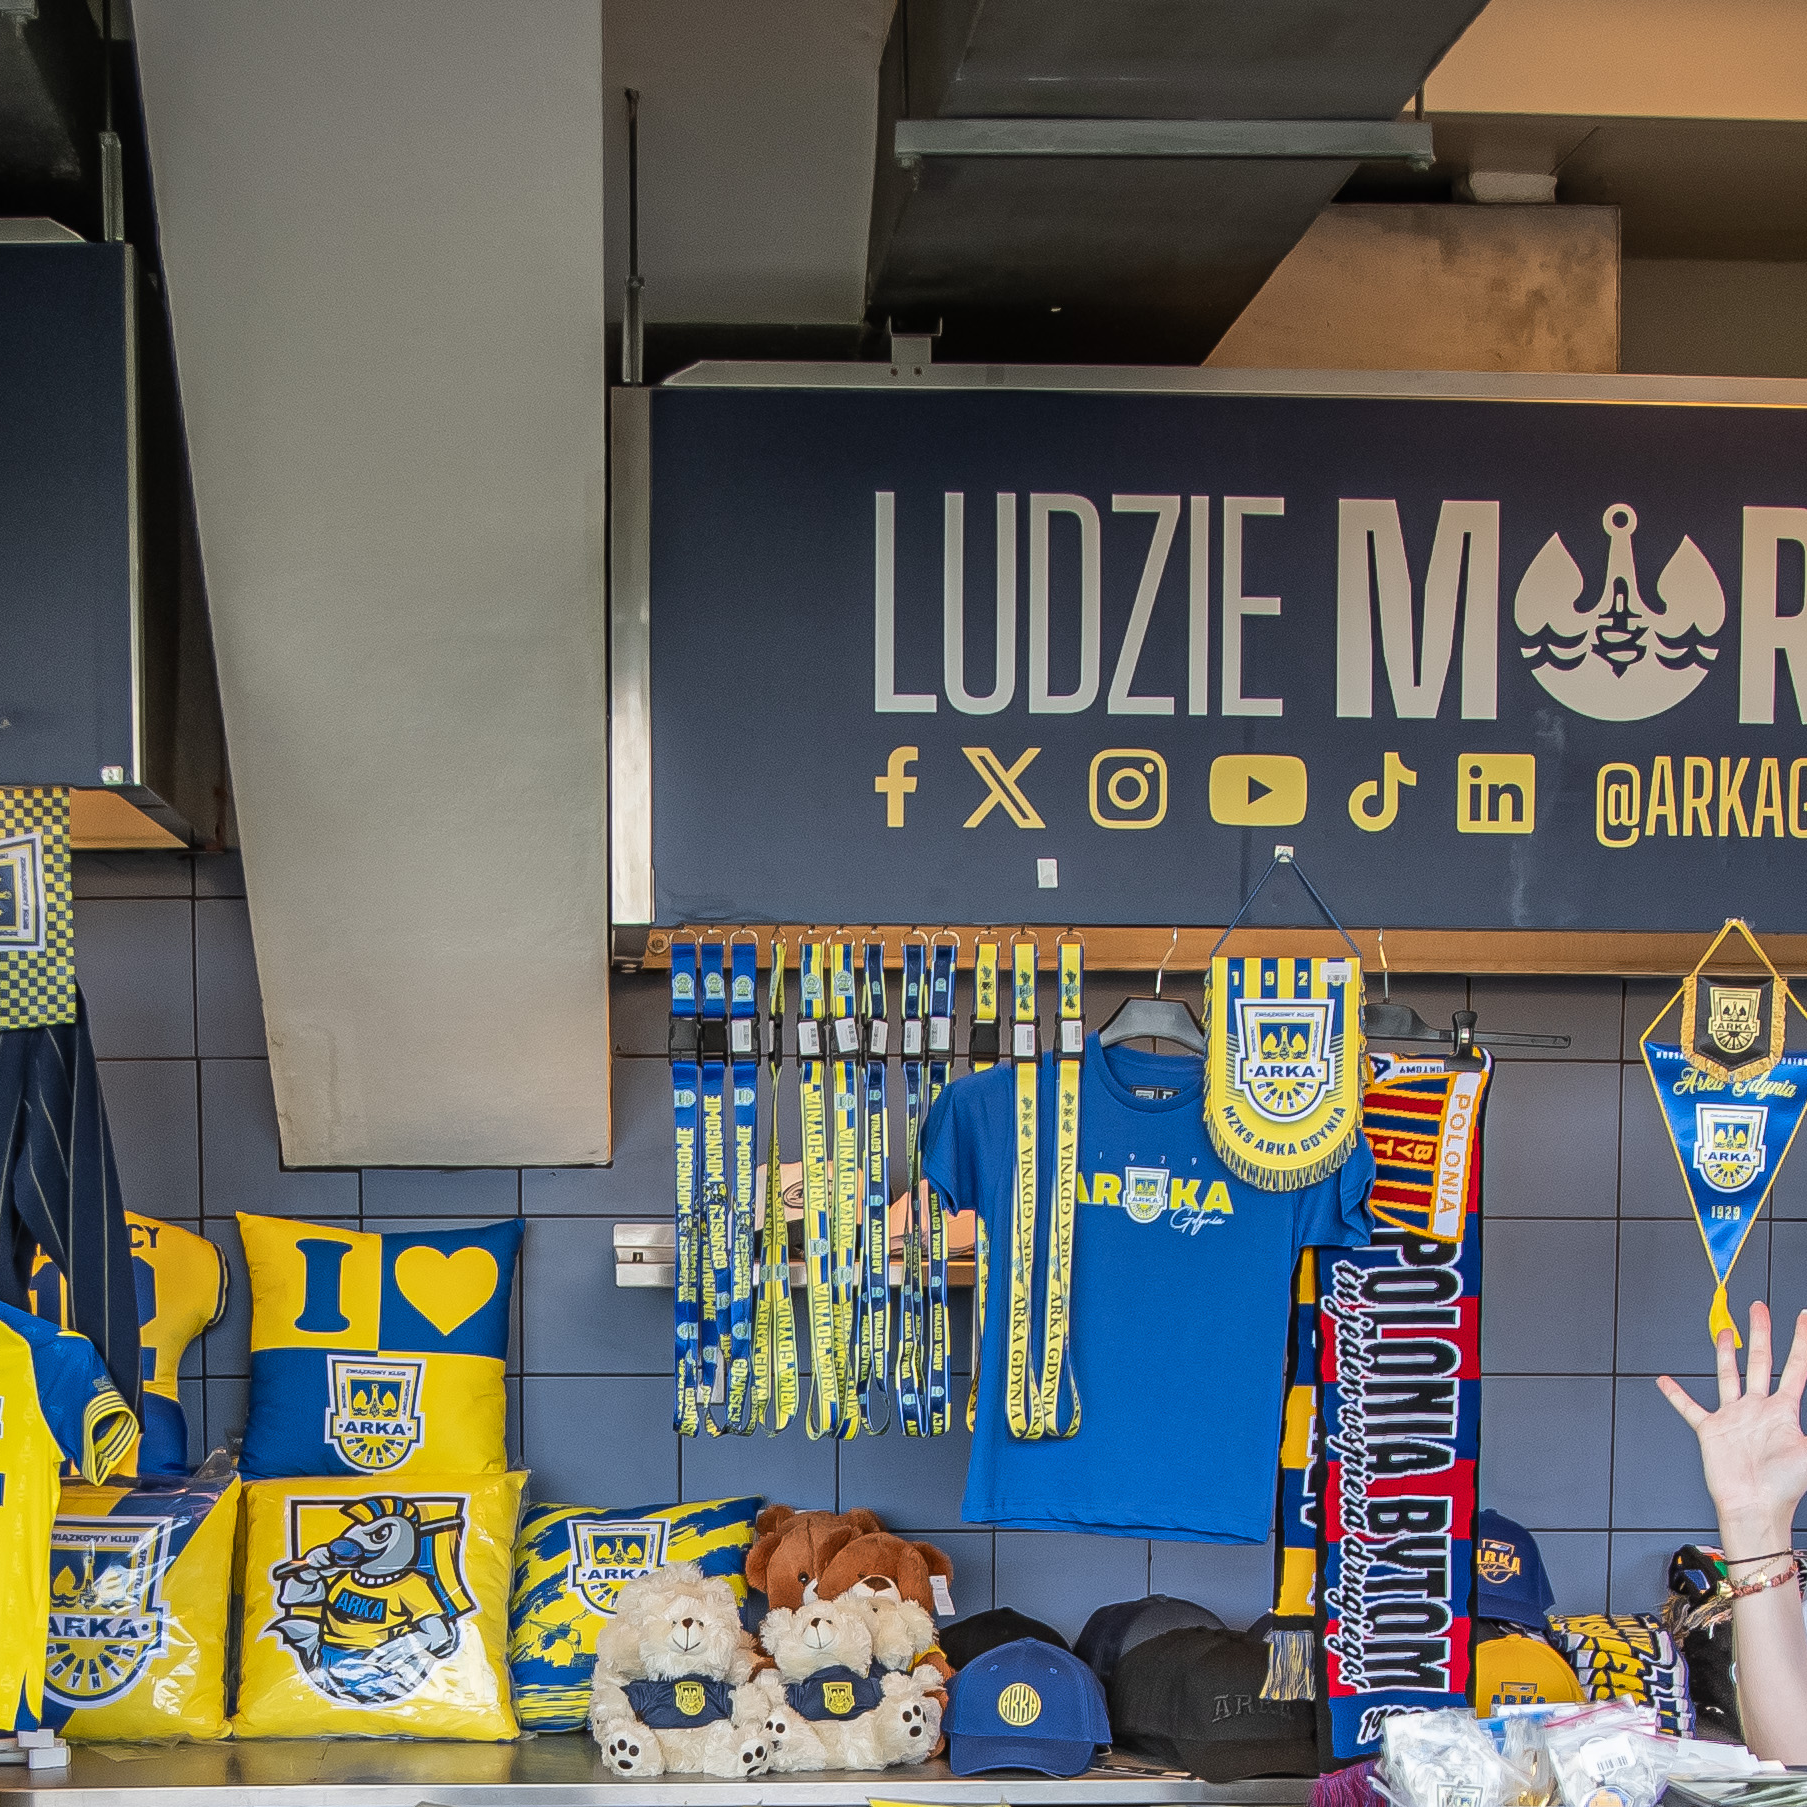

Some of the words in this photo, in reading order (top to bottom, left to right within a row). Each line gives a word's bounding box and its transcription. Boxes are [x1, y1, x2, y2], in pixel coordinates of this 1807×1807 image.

[875, 491, 1284, 717] LUDZIE
[1716, 1023, 1753, 1032] ARKA
[1254, 1065, 1316, 1079] ARKA
[1222, 1104, 1253, 1147] MZKS
[1253, 1137, 1297, 1155] ARKA
[1300, 1106, 1347, 1152] GDYNIA
[1438, 1094, 1471, 1214] POLONIA
[1709, 1152, 1751, 1162] ARKA
[1711, 1206, 1741, 1221] 1929
[295, 1238, 352, 1332] I
[1011, 1294, 1026, 1344] ARKA
[1048, 1293, 1064, 1342] ARKA
[1323, 1298, 1373, 1398] jeden
[1010, 1350, 1024, 1421] GDYNIA
[343, 1421, 407, 1437] ARKA
[1327, 1404, 1376, 1532] wspiera
[588, 1568, 650, 1580] ARKA
[1371, 1497, 1451, 1694] BYTOM
[48, 1617, 138, 1638] ARKA
[336, 1589, 386, 1623] ARKA
[1325, 1535, 1373, 1688] drugiego!
